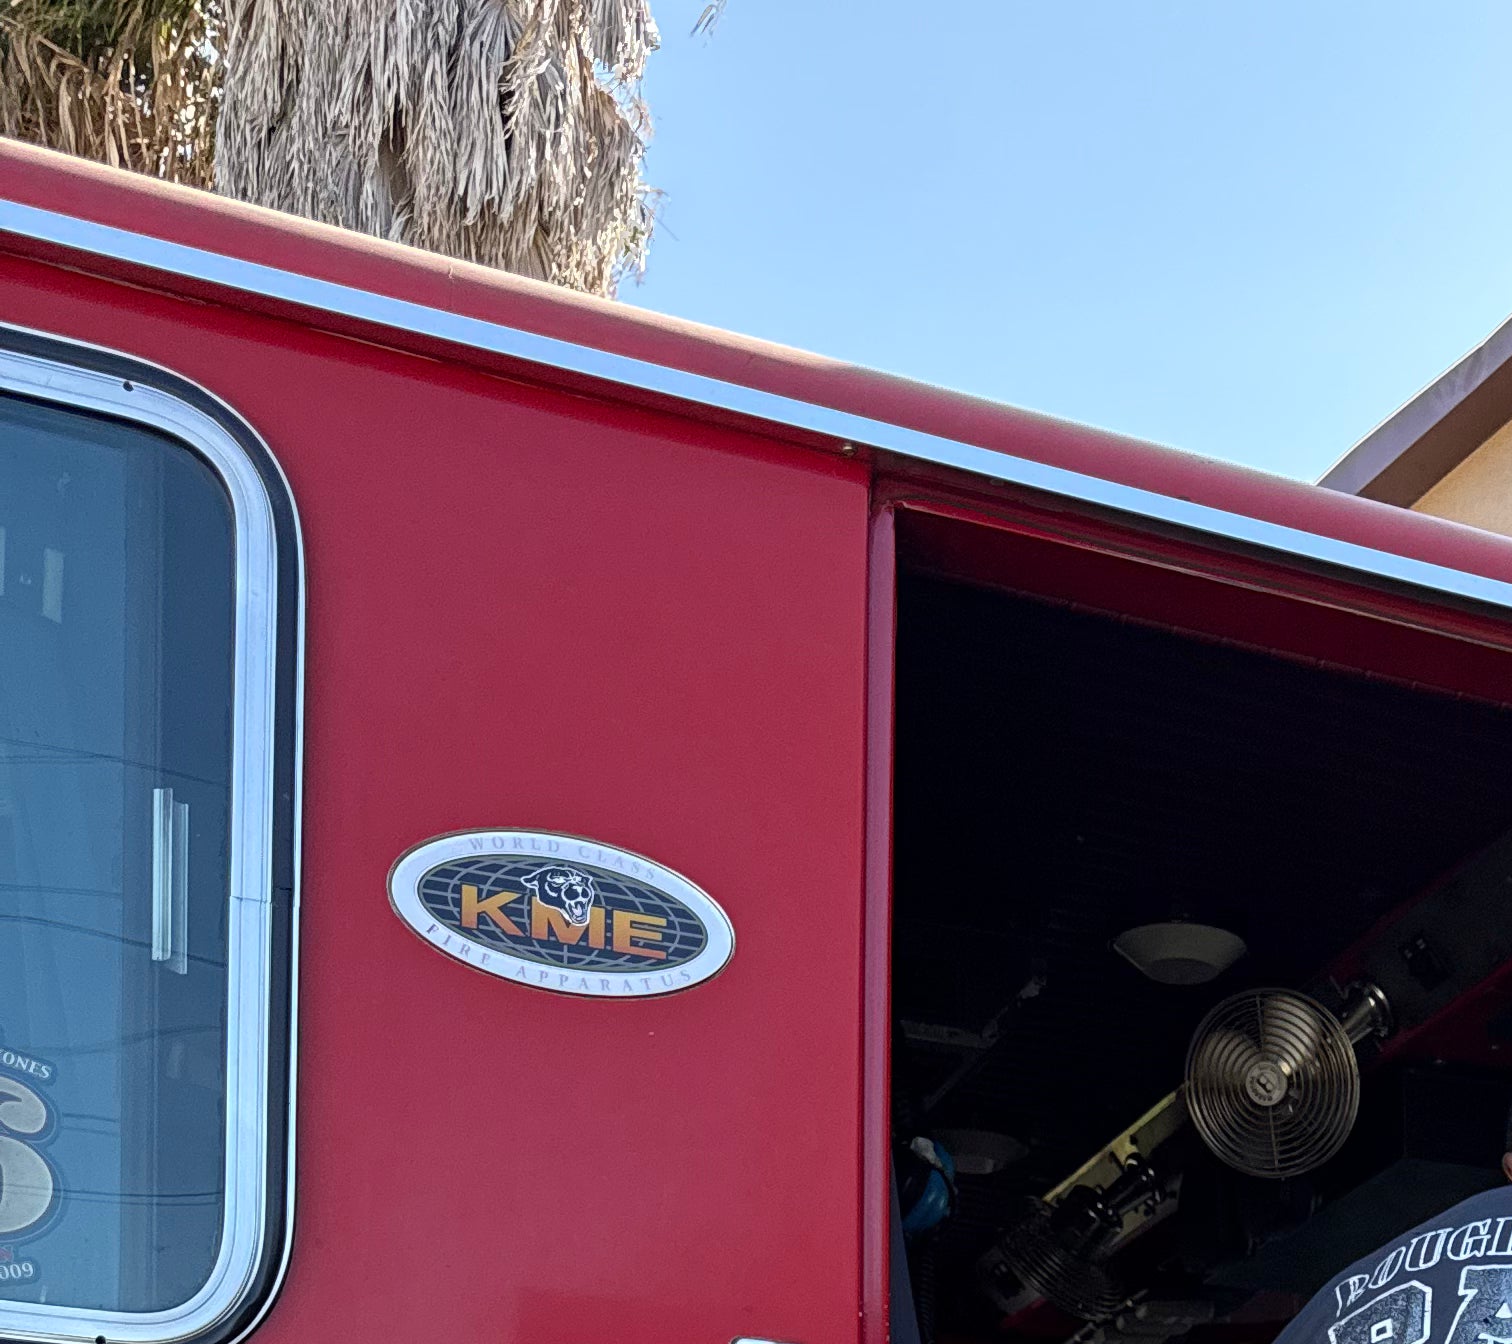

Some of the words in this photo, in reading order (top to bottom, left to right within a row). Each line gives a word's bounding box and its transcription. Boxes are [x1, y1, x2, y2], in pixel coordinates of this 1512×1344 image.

[467, 836, 561, 854] WORLD
[578, 847, 657, 881] CLASS
[425, 922, 492, 966] FIRE
[515, 965, 692, 993] APPARATUS
[461, 883, 668, 961] KME
